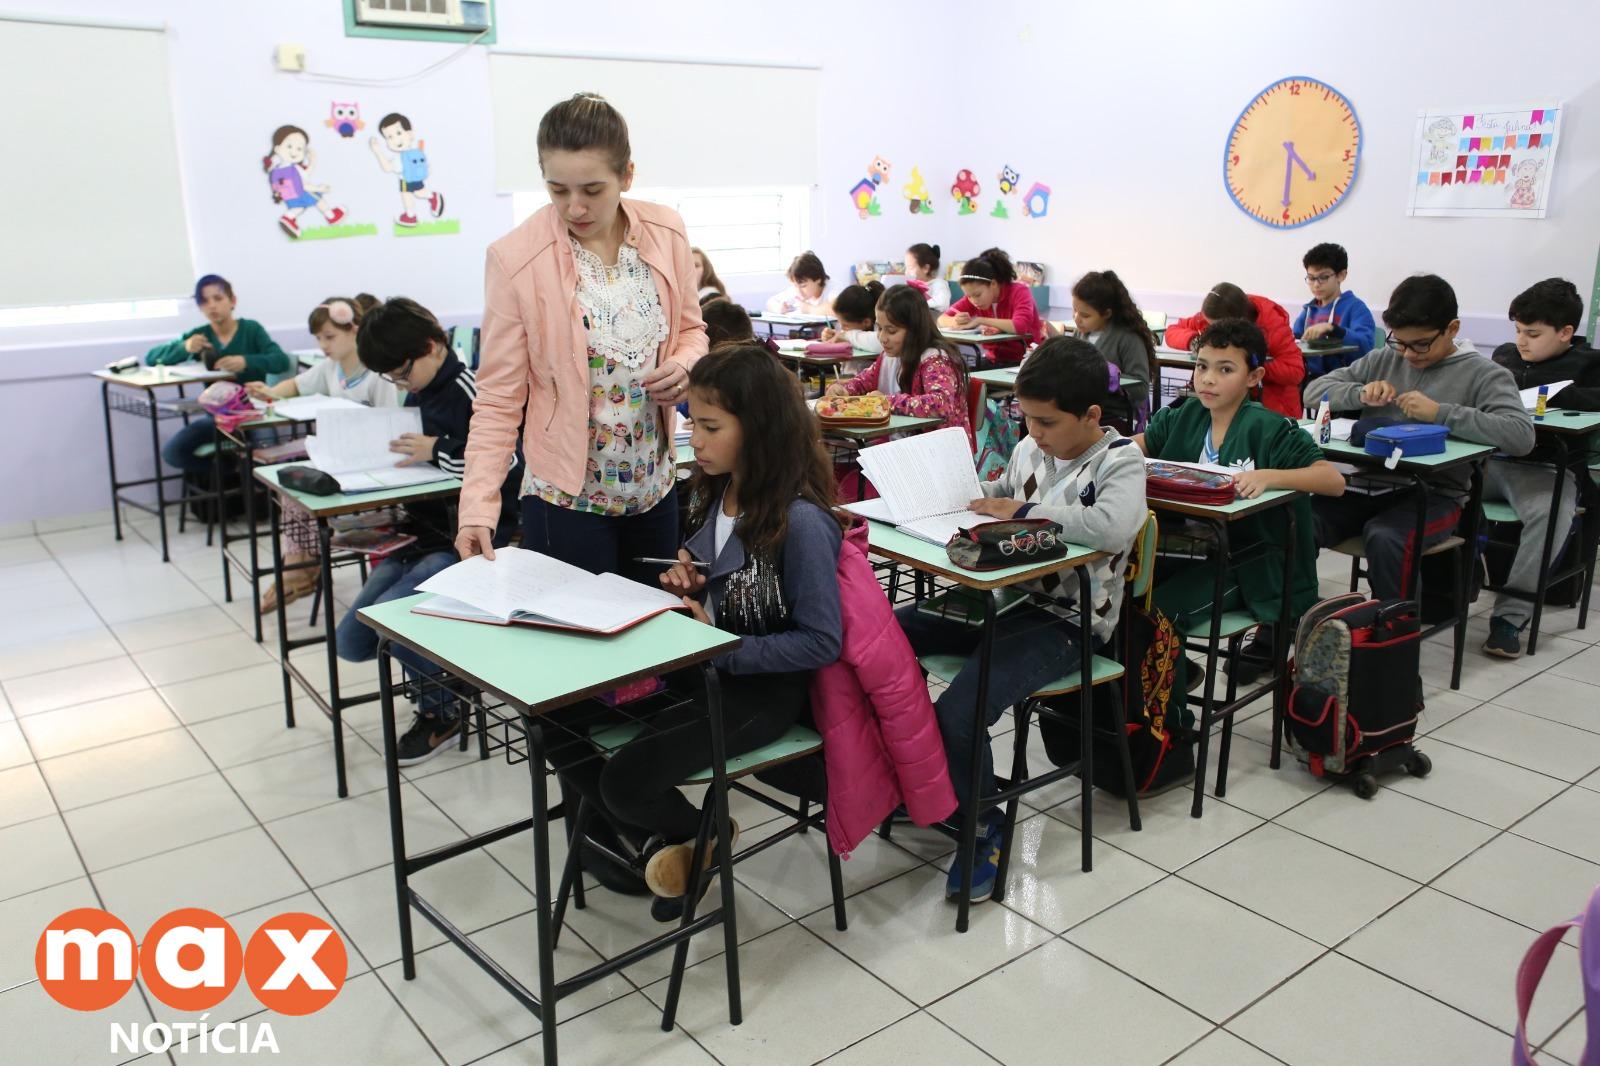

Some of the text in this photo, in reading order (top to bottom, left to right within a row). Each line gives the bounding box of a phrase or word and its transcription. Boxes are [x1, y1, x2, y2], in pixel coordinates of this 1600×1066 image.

[1289, 83, 1301, 95] 12
[1233, 155, 1240, 166] 9
[1342, 149, 1351, 162] 3
[1282, 207, 1290, 221] 6
